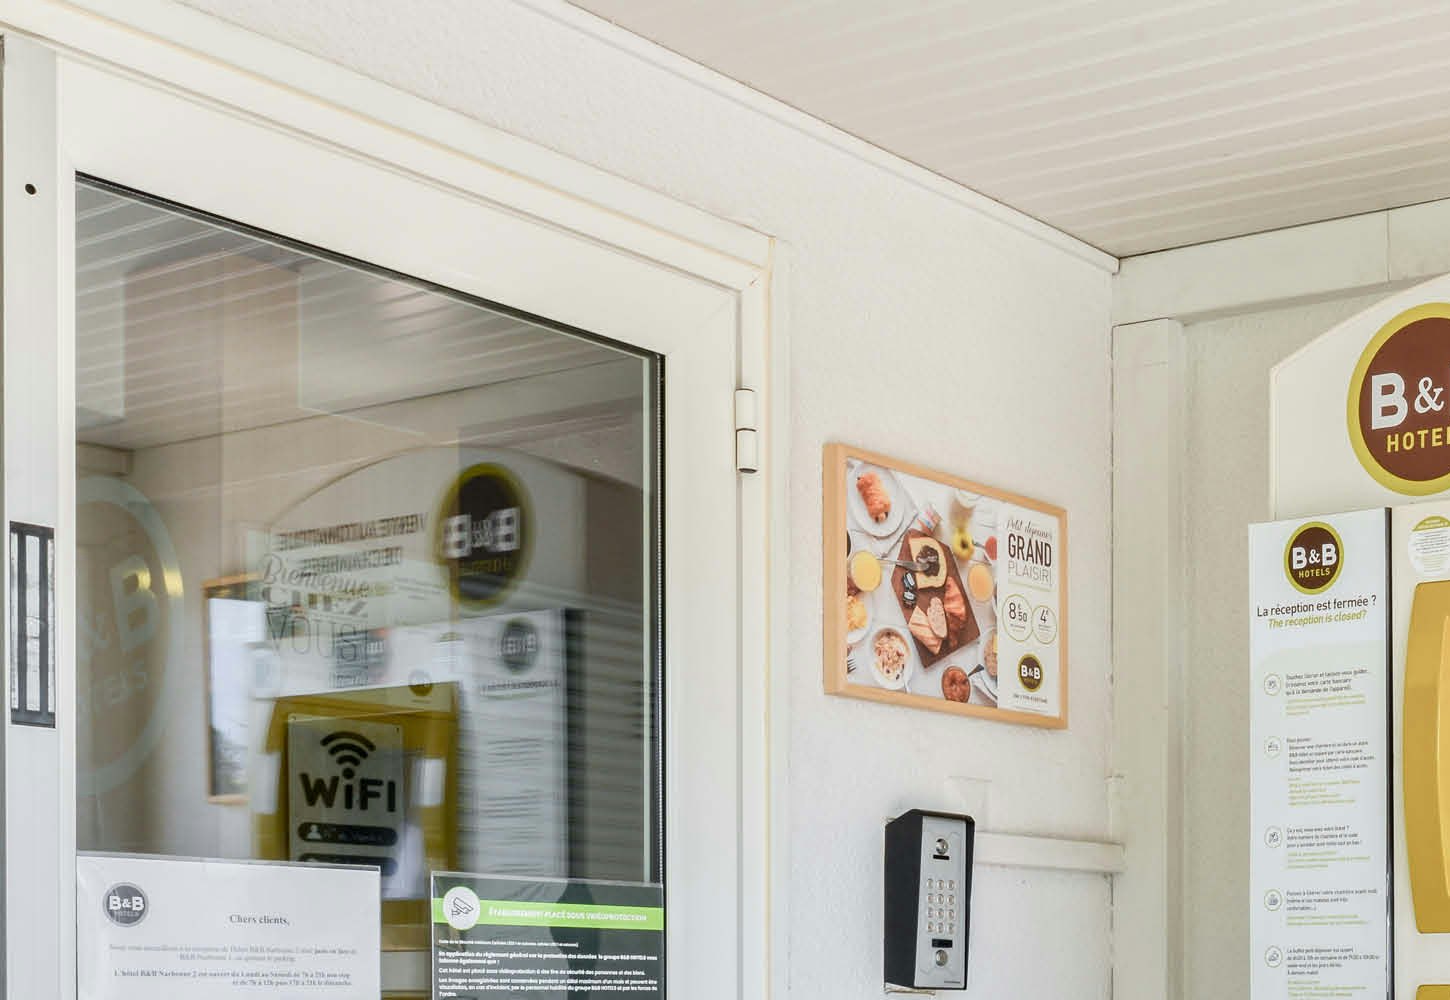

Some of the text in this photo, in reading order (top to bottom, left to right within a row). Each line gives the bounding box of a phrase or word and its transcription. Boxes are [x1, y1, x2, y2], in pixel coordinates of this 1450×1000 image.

[1008, 532, 1052, 567] GRAND
[1292, 543, 1337, 570] B&B
[1298, 568, 1330, 578] HOTELS
[1257, 594, 1377, 617] La réception est fermée ?
[1268, 609, 1368, 629] The reception is closed?
[1021, 664, 1040, 680] B&B
[109, 895, 144, 911] B&B
[229, 914, 290, 926] Chers clients,
